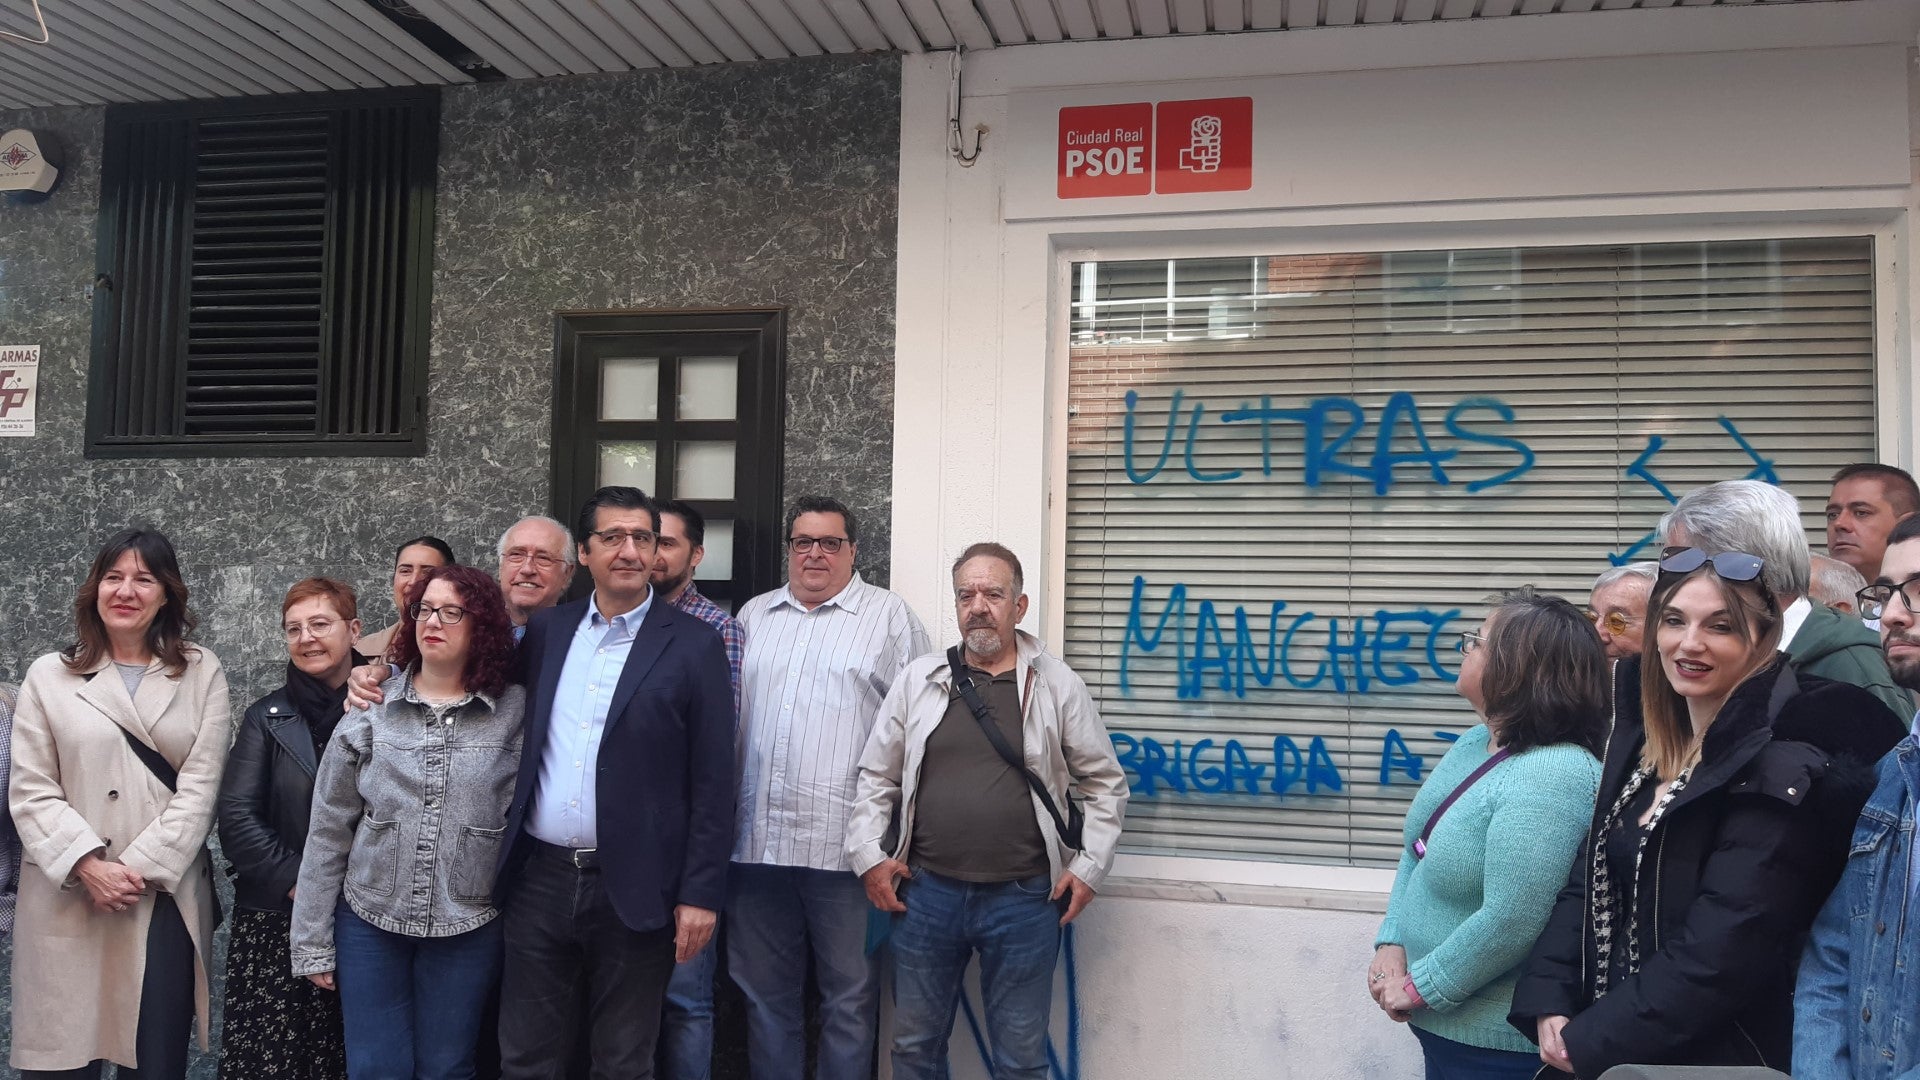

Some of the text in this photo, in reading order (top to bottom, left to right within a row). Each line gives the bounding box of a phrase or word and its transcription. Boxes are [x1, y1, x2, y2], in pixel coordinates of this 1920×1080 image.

[1067, 127, 1143, 145] Ciudad Real
[1065, 146, 1144, 177] PSOE
[0, 350, 38, 363] ARMAS
[1123, 390, 1536, 495] ULTRAS
[1109, 732, 1342, 797] BRIGADA
